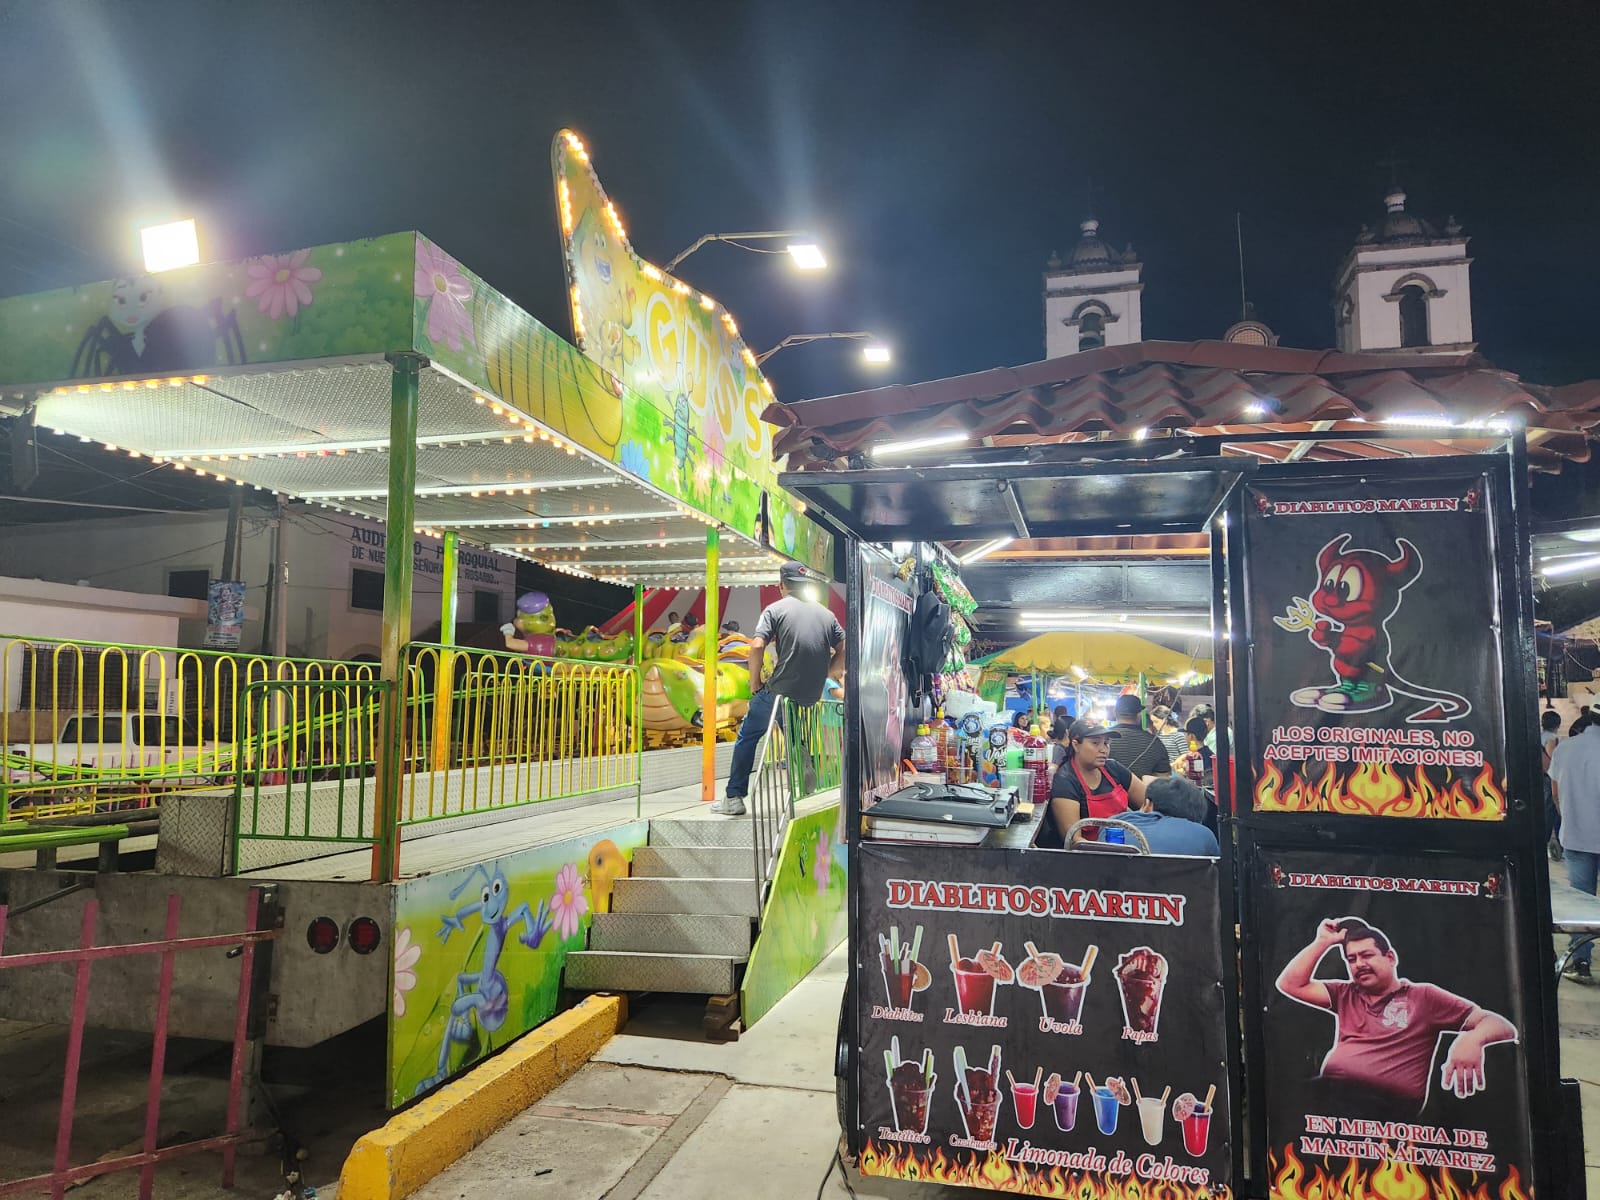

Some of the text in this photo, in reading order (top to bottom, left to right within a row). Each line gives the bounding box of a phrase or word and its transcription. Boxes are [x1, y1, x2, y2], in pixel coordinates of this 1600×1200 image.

[1274, 498, 1459, 515] DIABLITOS MARTIN
[352, 545, 364, 560] DE
[436, 545, 501, 572] PROQUIAL
[1272, 726, 1474, 748] ¡LOS ORIGINALES, NO
[1264, 745, 1483, 767] ACEPTES IMITACIONES!
[1289, 873, 1480, 895] DIABLITOS MARTIN
[888, 879, 1186, 926] DIABLITOS MARTIN
[871, 1006, 924, 1023] Diablitos
[943, 1008, 1008, 1028] Lesbiana
[1039, 1017, 1083, 1036] Uvola
[1121, 1026, 1159, 1045] Papas
[1304, 1114, 1488, 1149] EN MEMORIA DE
[1004, 1138, 1210, 1184] Limonada de Colores
[1300, 1136, 1496, 1172] MARTÍN ÁLVAREZ
